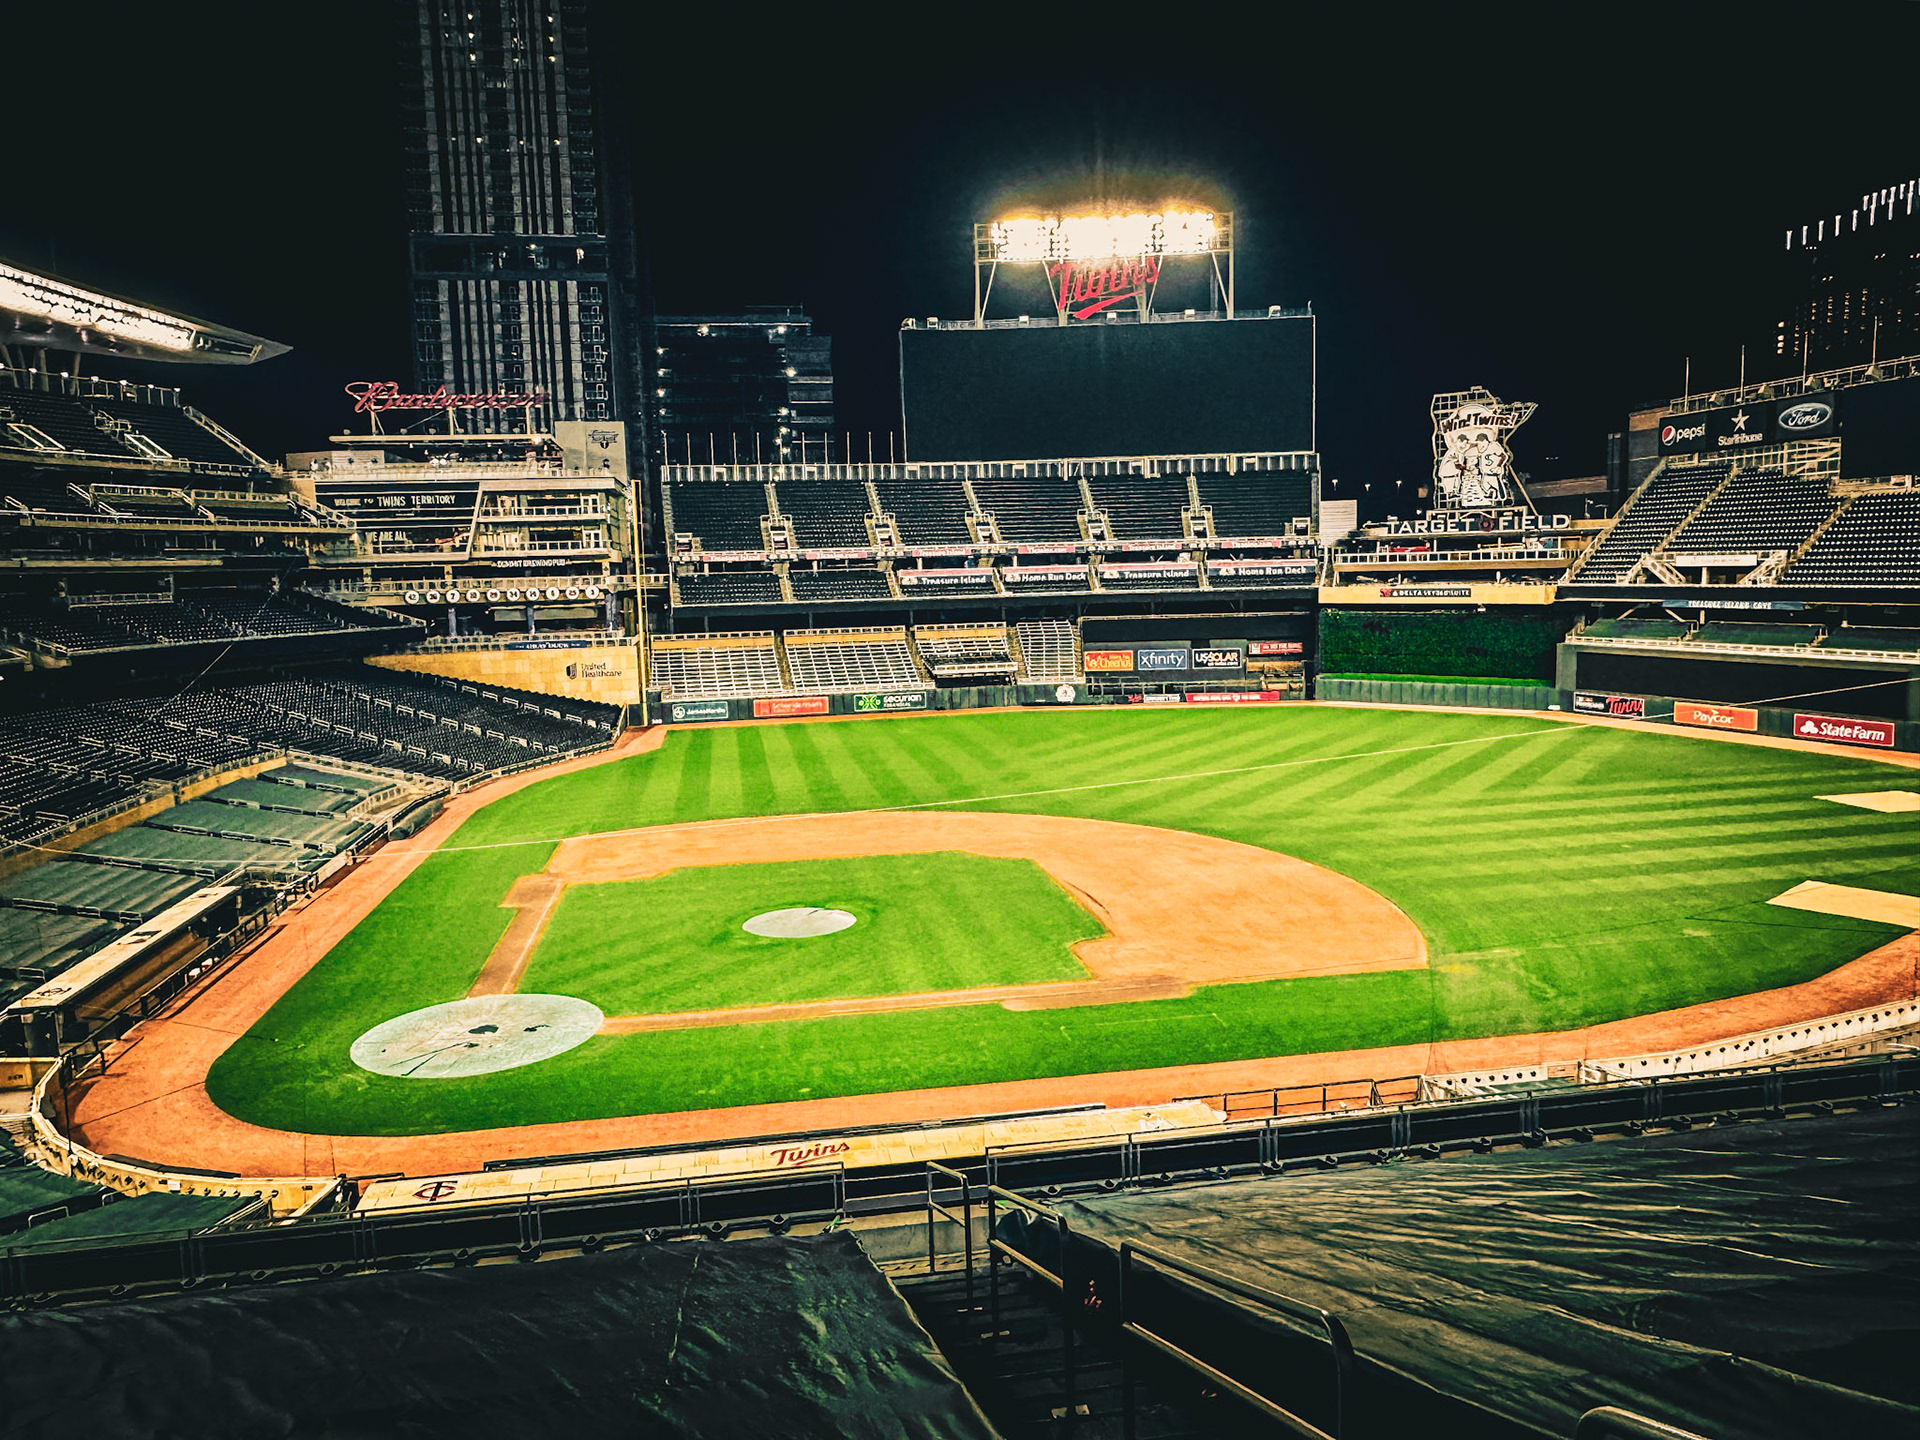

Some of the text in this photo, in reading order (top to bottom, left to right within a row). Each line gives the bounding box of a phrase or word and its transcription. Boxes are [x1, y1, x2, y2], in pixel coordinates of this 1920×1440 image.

[1049, 256, 1159, 319] Twins
[1442, 412, 1518, 433] Win! Twins!
[1788, 409, 1821, 427] Ford
[1676, 423, 1706, 444] pepsi
[377, 496, 405, 507] TWINS
[411, 494, 456, 505] TERRITORY
[1387, 514, 1571, 535] TARGET FIELD
[1022, 572, 1087, 583] Home Run Deck
[1238, 566, 1307, 576] Home Run Deck
[1399, 589, 1423, 597] DELTA
[581, 662, 606, 672] United
[1141, 652, 1184, 668] xfinity
[582, 670, 622, 678] Healthcare
[883, 694, 922, 703] securian
[1606, 696, 1643, 715] Twins
[1693, 710, 1734, 725] Paycor
[770, 1142, 850, 1167] Twins
